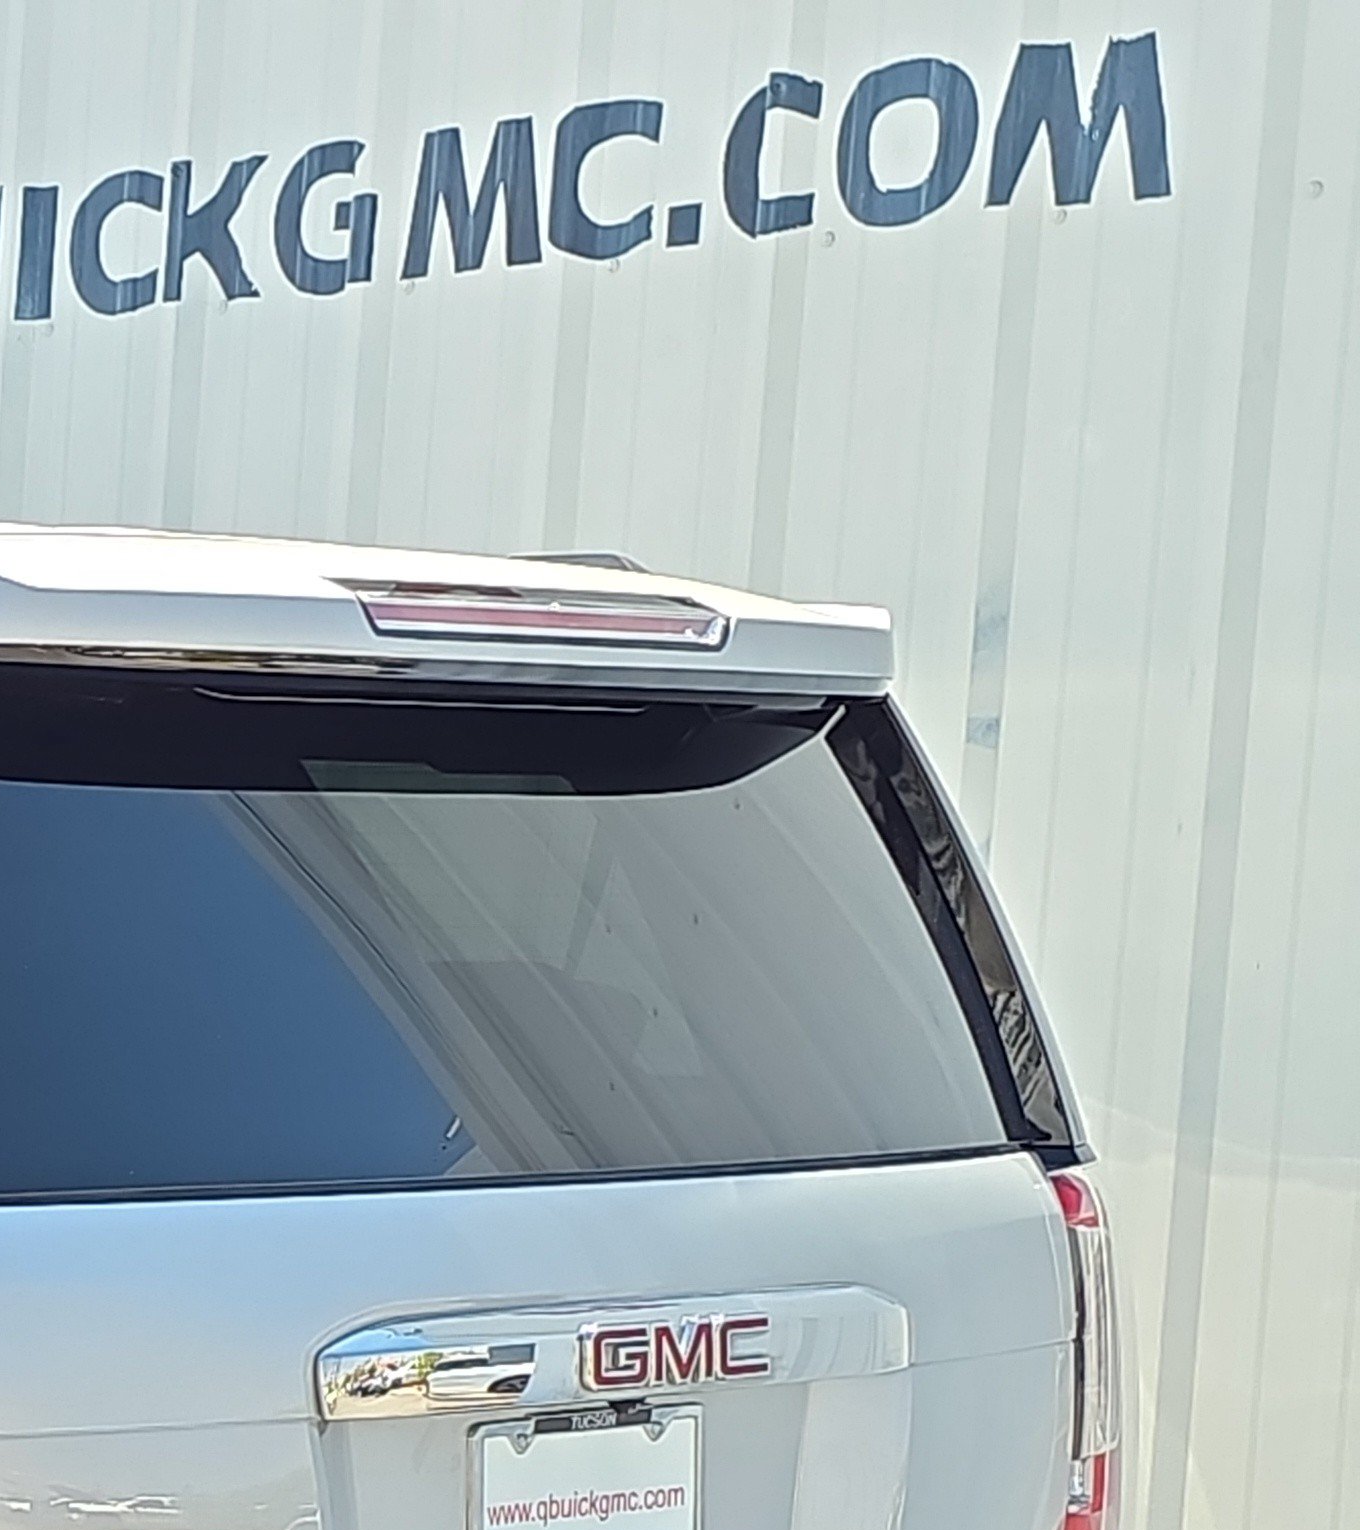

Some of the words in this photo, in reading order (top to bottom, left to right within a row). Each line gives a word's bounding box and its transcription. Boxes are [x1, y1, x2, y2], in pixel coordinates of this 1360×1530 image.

[590, 1317, 769, 1389] GMC
[571, 1412, 618, 1430] TUCSON
[487, 1486, 685, 1526] www.qbuickgmc.com
